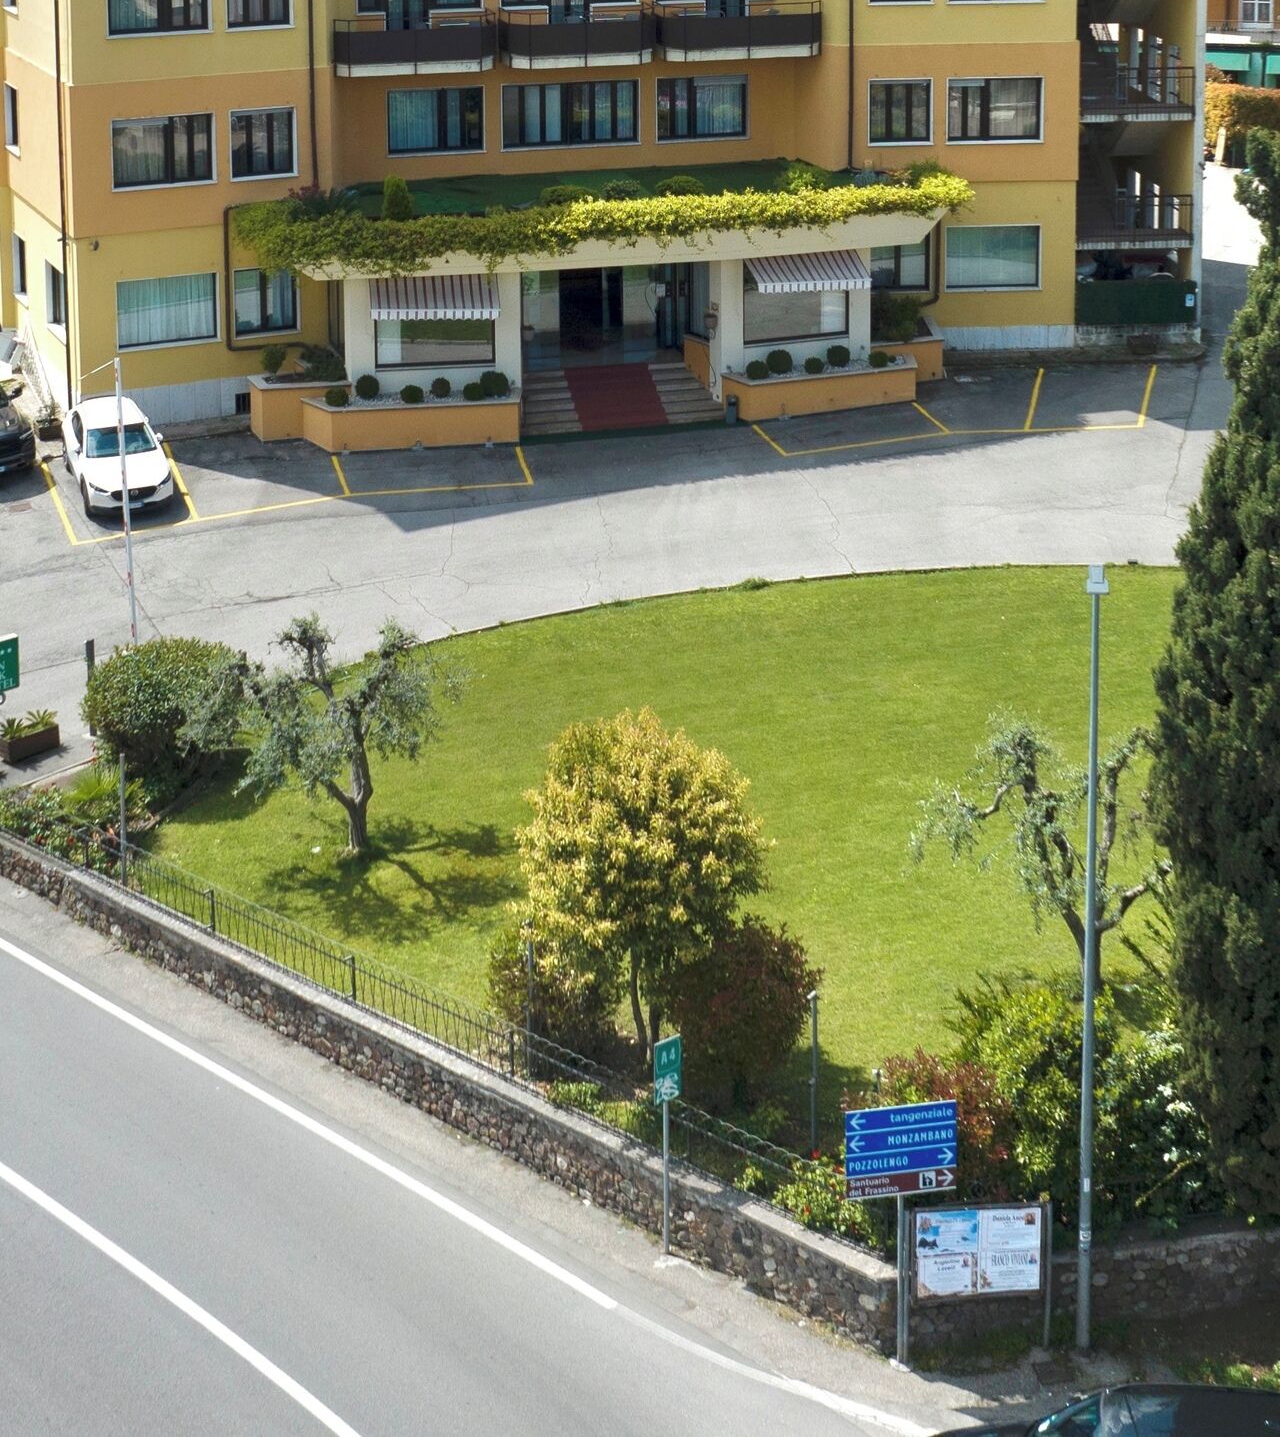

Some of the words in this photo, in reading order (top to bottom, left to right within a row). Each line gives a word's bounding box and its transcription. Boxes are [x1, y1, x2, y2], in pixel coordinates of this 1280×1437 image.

[890, 1107, 953, 1123] tangenziale
[888, 1128, 954, 1146] MONZAMBANO
[848, 1156, 909, 1172] POZZOLENGO
[849, 1177, 890, 1188] Santuario
[849, 1187, 862, 1197] del
[865, 1185, 900, 1196] Frassino
